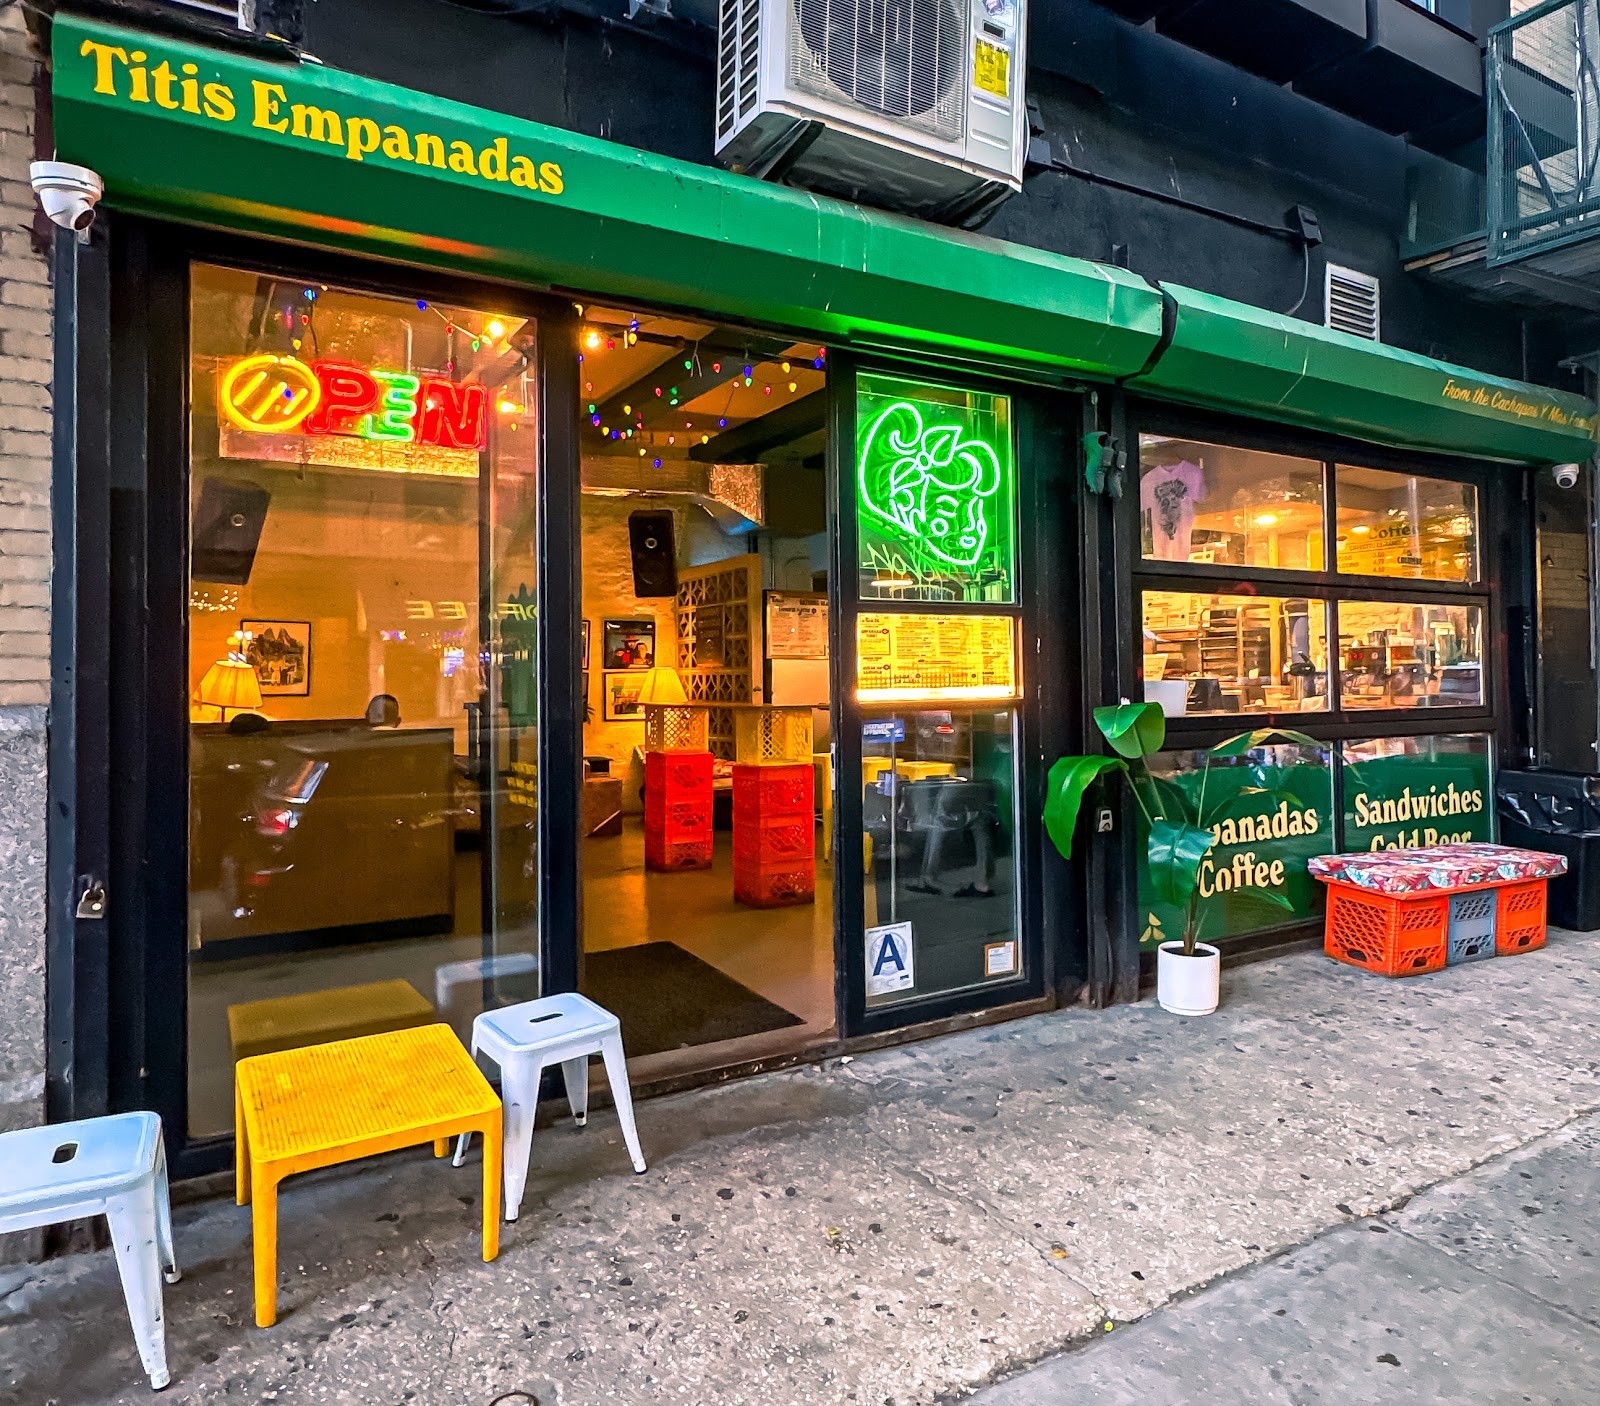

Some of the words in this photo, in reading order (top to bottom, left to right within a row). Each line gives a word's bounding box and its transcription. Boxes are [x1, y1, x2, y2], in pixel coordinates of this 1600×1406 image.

[80, 39, 236, 122] Titis
[251, 79, 564, 195] Empanadas
[221, 354, 488, 451] OPEN
[1442, 379, 1471, 403] From
[1473, 387, 1489, 406] the
[1491, 391, 1538, 419] Cachapas
[1540, 405, 1549, 418] Y
[1200, 799, 1320, 857] panadas
[1355, 782, 1482, 828] Sandwiches
[1197, 851, 1285, 898] Coffee
[873, 934, 905, 976] A
